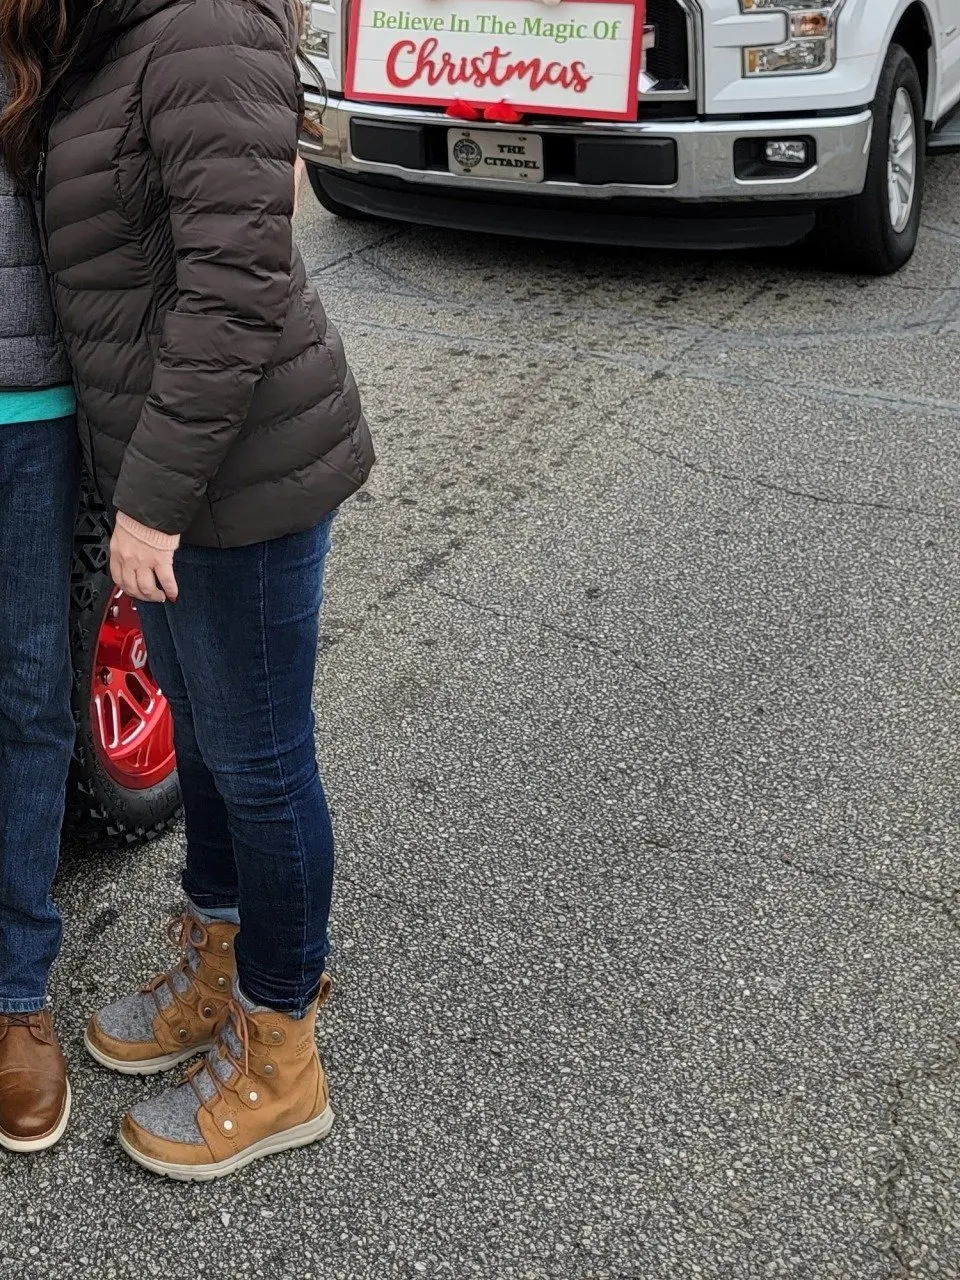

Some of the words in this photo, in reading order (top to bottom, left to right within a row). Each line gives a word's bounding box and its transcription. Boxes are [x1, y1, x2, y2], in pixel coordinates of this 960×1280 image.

[371, 10, 445, 32] Believe
[449, 14, 471, 33] In
[477, 15, 517, 36] The
[523, 17, 588, 44] Magic
[593, 20, 622, 41] Of
[385, 36, 594, 94] Christmas
[497, 143, 526, 155] THE
[483, 156, 541, 170] CITADEL
